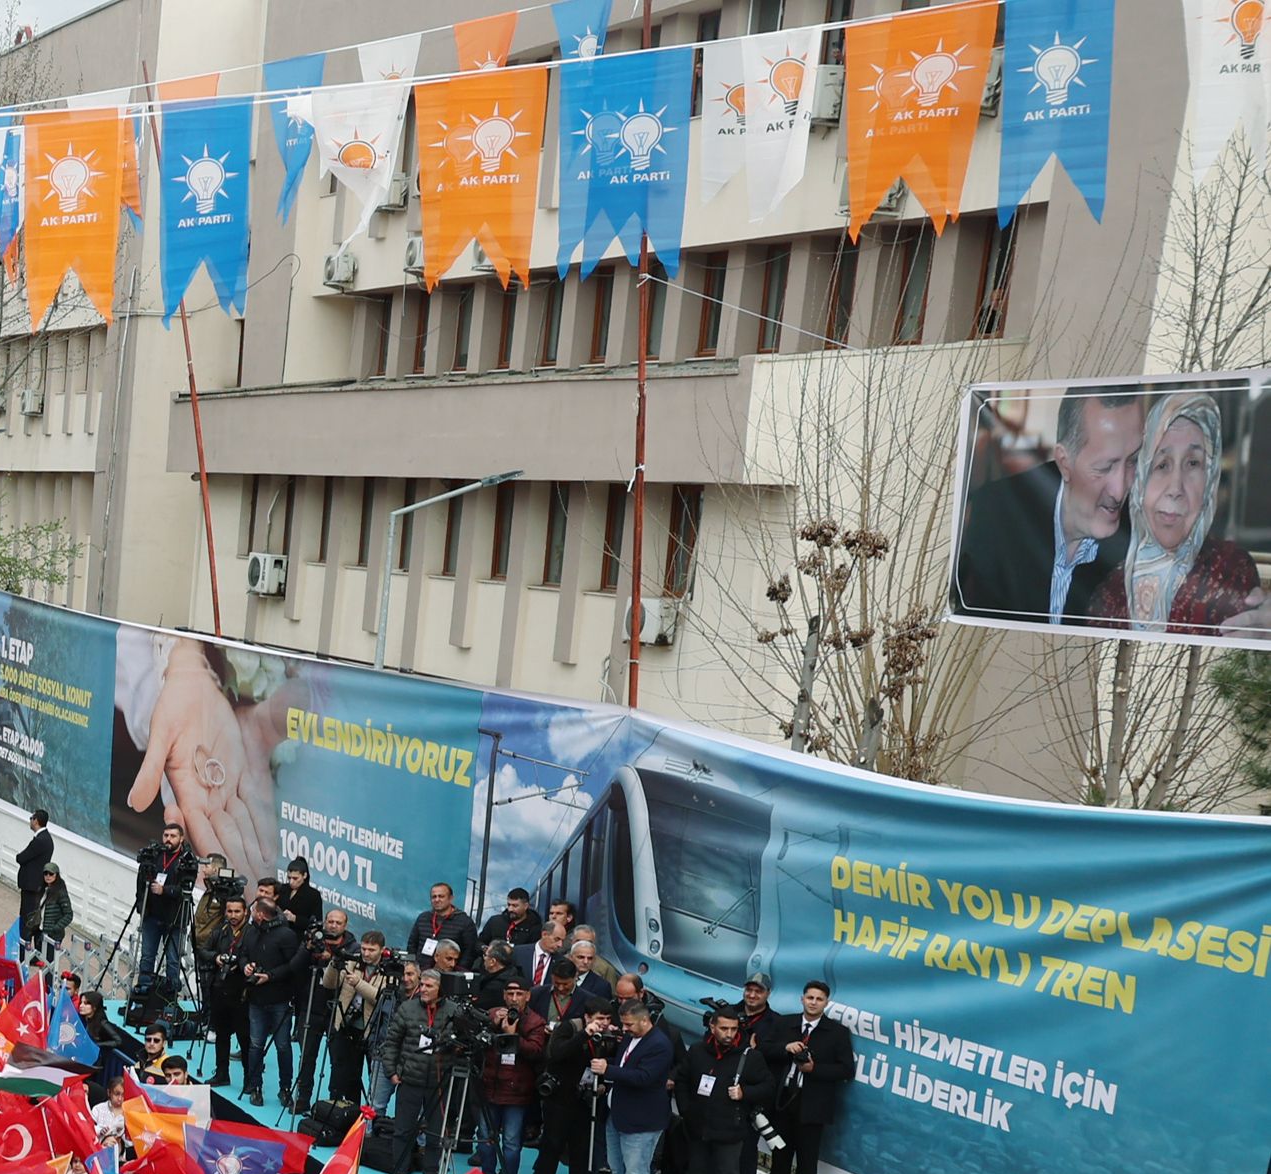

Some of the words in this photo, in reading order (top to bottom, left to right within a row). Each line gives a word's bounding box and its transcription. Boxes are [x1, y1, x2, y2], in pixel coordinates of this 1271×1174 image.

[718, 127, 736, 135] AK
[766, 121, 785, 133] AK
[893, 111, 913, 121] AK
[1023, 109, 1045, 122] AK
[459, 175, 479, 186] AK
[609, 174, 630, 185] AK
[40, 216, 59, 227] AK
[178, 217, 194, 228] AK
[1, 635, 7, 659] 1.
[9, 637, 34, 666] ETAP
[18, 671, 38, 690] ADET
[37, 677, 65, 700] SOSYAL
[65, 684, 93, 708] KONUT
[2, 726, 20, 747] ETAP
[19, 734, 45, 758] 20.000
[286, 707, 473, 788] EVLENDİRİYORUZ
[281, 801, 327, 832] EVLENEN
[328, 814, 404, 860] ÇİFTLERİMİZE
[280, 829, 351, 882] 100.000
[354, 857, 378, 893] TL
[341, 892, 377, 921] DESTEĞİ
[831, 856, 934, 909] DEMİR
[938, 879, 1041, 930] YOLU
[1038, 898, 1271, 979] DEPLASESİ
[833, 909, 929, 961] HAFİF
[923, 933, 1031, 988] RAYLI
[1035, 957, 1137, 1015] TREN
[894, 1019, 1047, 1095] HİZMETLER
[1051, 1061, 1118, 1115] İÇİN
[891, 1064, 1013, 1133] LİDERLİK
